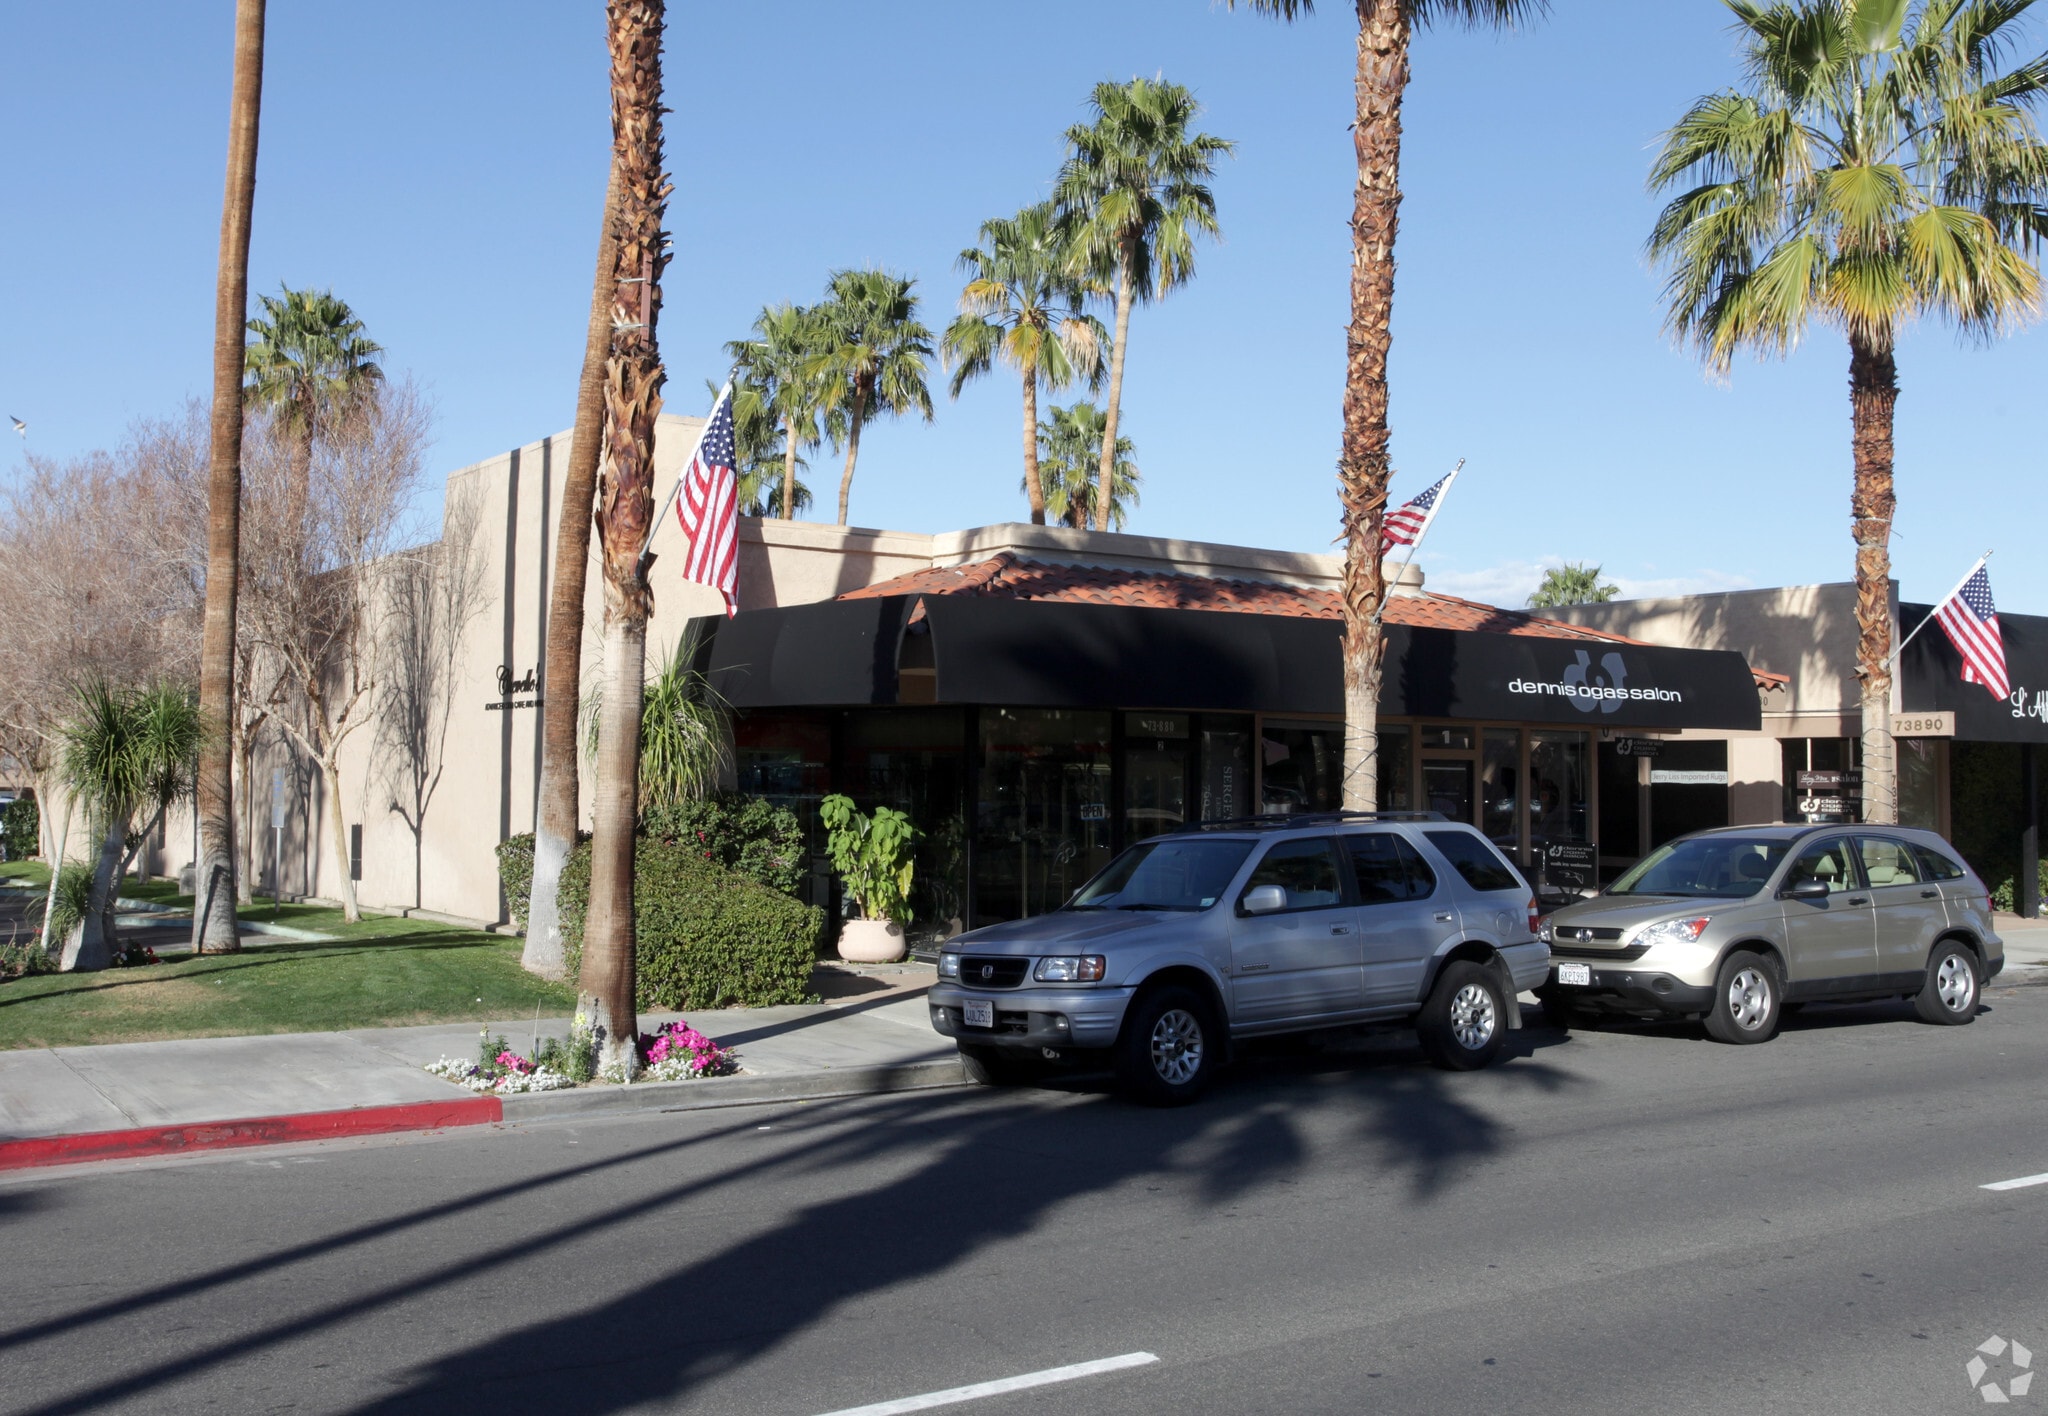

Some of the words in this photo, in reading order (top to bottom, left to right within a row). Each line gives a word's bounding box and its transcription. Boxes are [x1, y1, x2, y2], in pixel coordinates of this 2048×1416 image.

[1508, 678, 1577, 697] dennis
[1578, 686, 1629, 700] ogas
[1630, 687, 1682, 702] salon
[1895, 719, 1943, 731] 73890
[1653, 773, 1667, 782] Jerry
[1681, 773, 1709, 782] Imported
[1711, 773, 1726, 783] Rugs
[1083, 806, 1103, 818] OPEN
